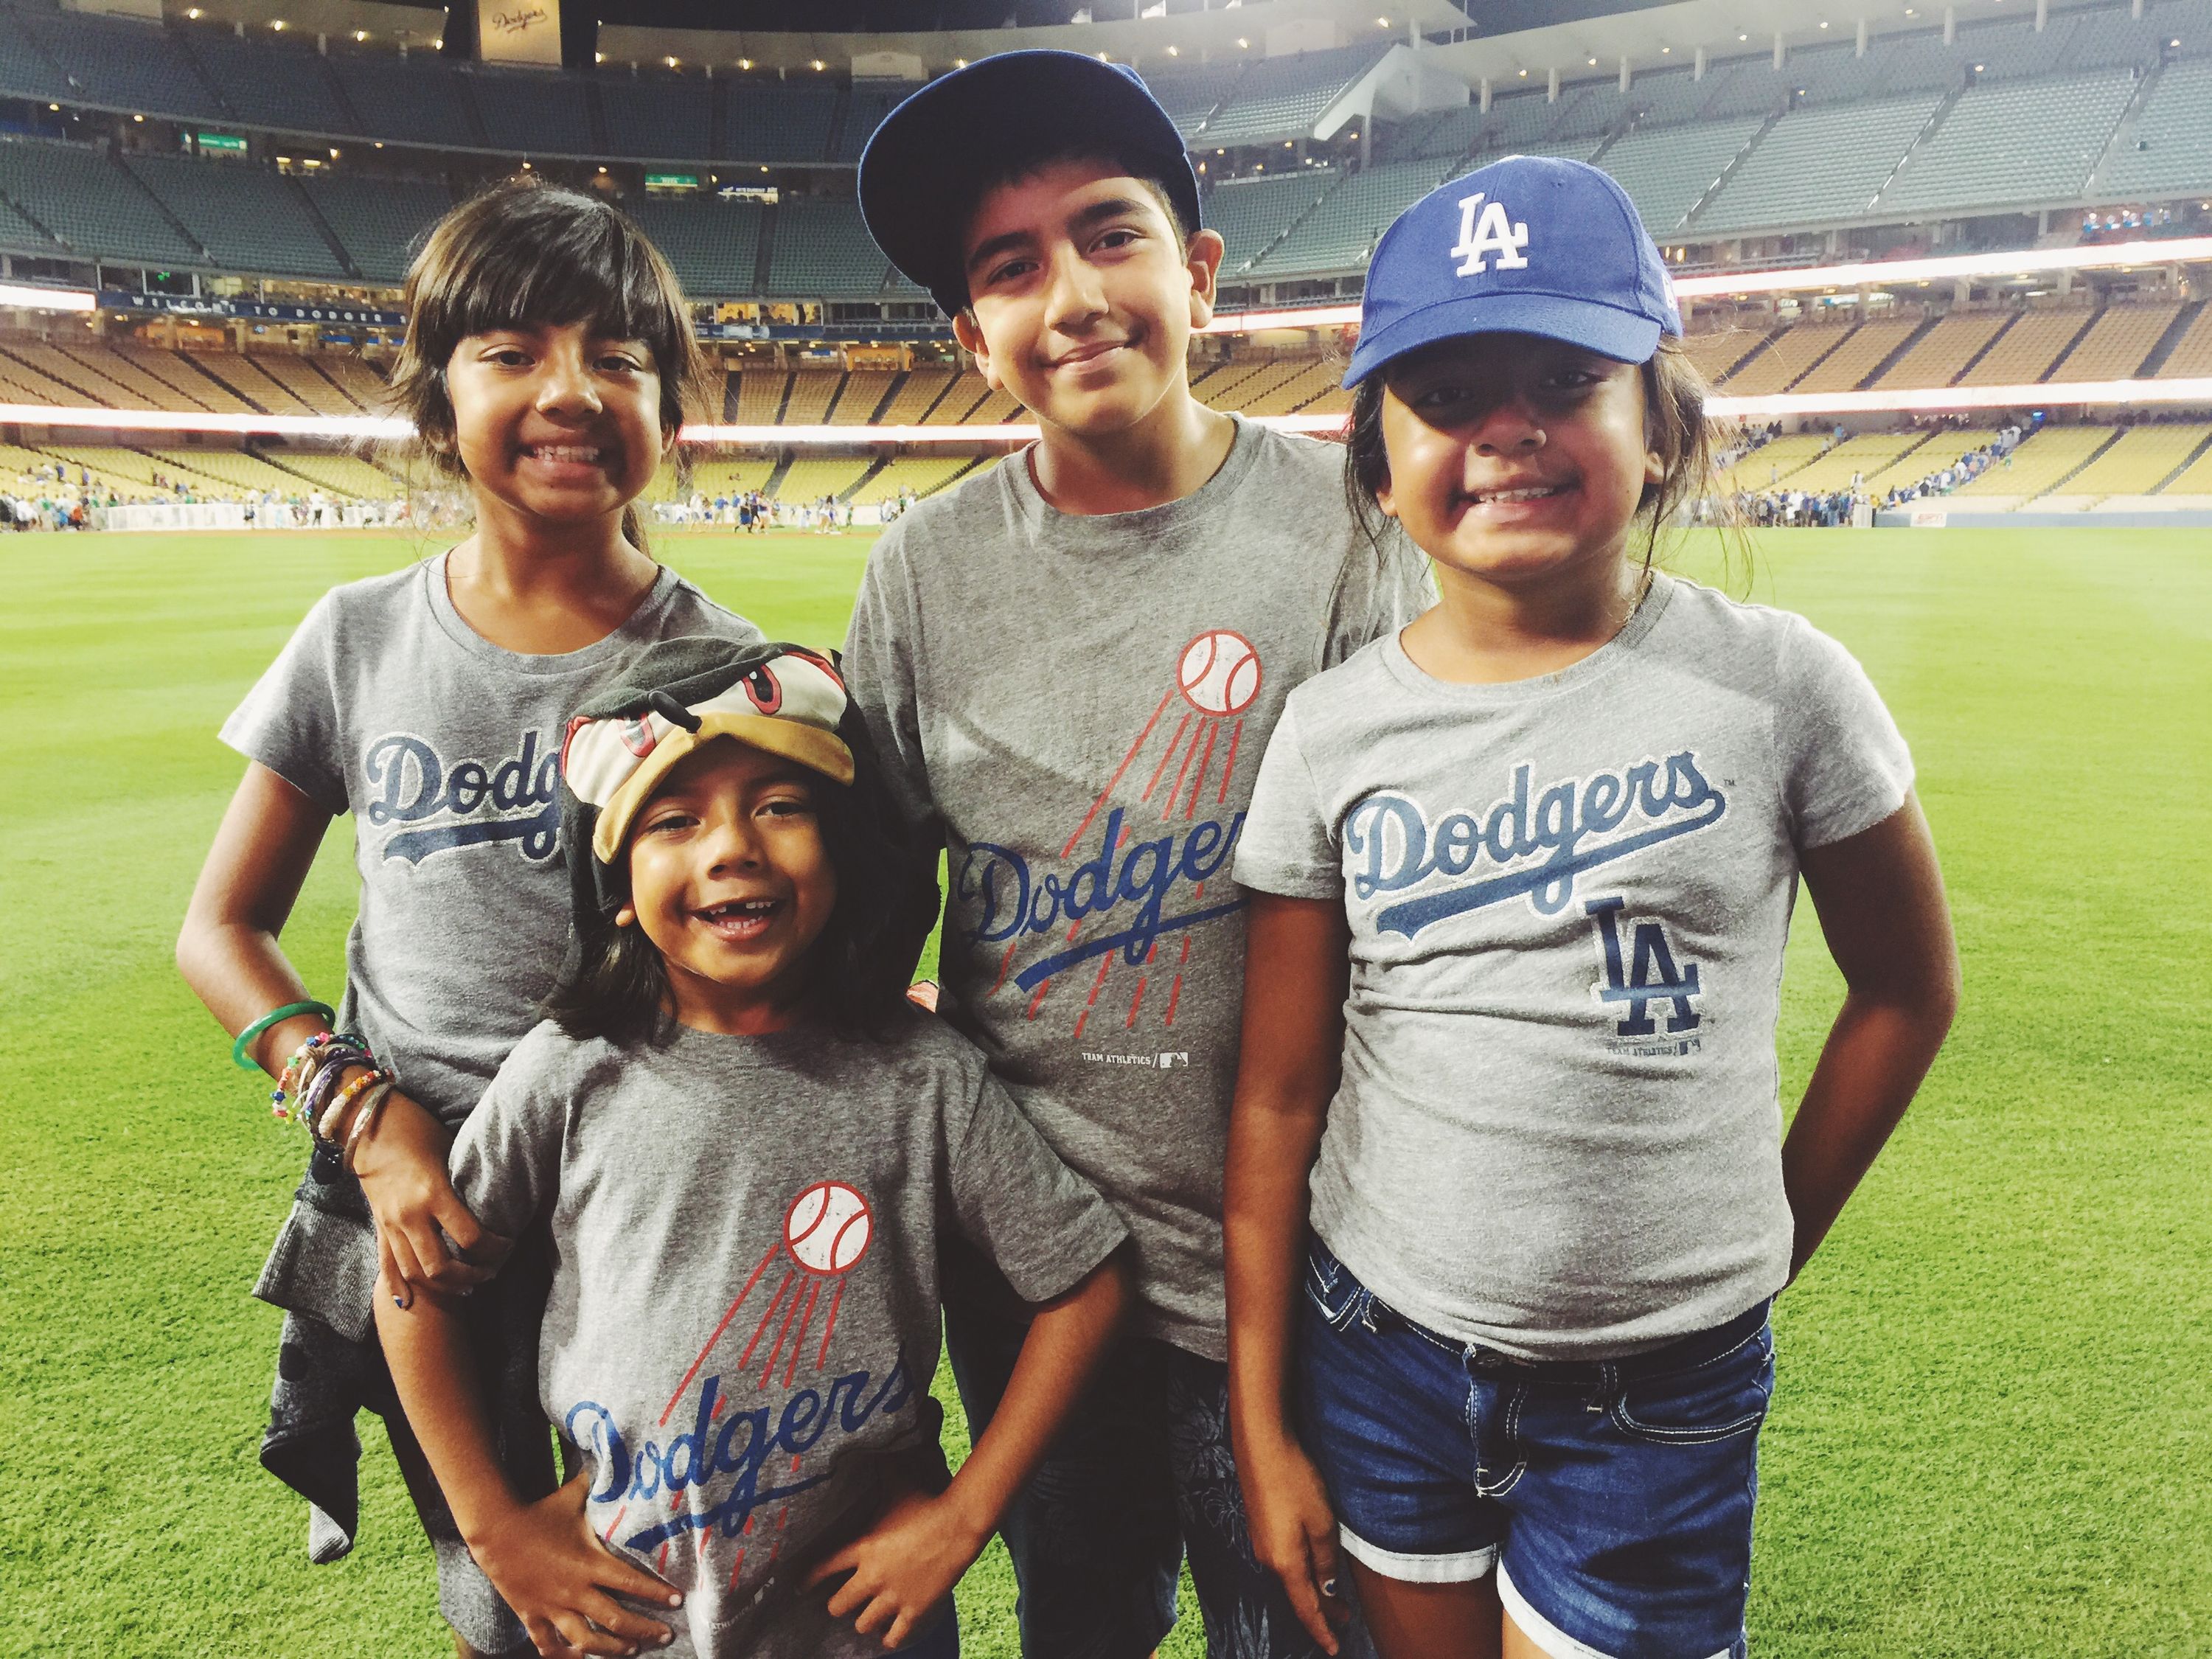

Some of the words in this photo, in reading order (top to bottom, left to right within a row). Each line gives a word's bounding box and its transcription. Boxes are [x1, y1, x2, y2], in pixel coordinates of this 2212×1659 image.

[1450, 192, 1528, 278] LA
[365, 726, 562, 866] Dodg
[1344, 748, 1728, 941] Dodgers
[961, 807, 1248, 977] Dodge
[1585, 896, 1701, 1037] LA
[1081, 1052, 1104, 1062] TEAM
[1105, 1054, 1151, 1065] ATHLETICS
[565, 1339, 916, 1553] Dodgers
